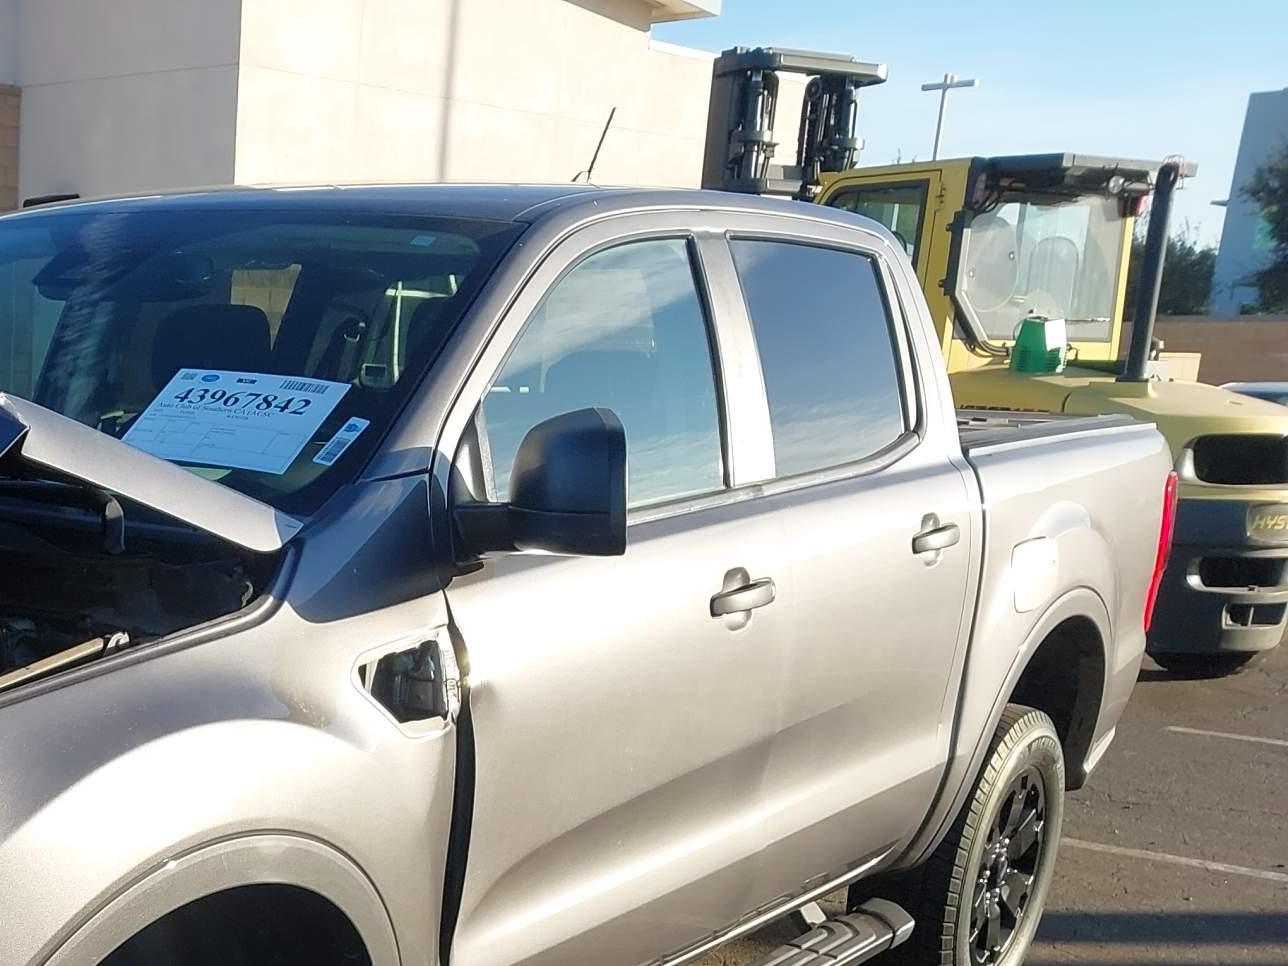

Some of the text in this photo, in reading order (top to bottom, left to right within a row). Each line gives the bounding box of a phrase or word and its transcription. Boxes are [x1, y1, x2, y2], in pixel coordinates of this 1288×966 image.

[158, 401, 172, 409] Auto
[174, 387, 312, 416] 43967842
[1252, 514, 1288, 530] HYS
